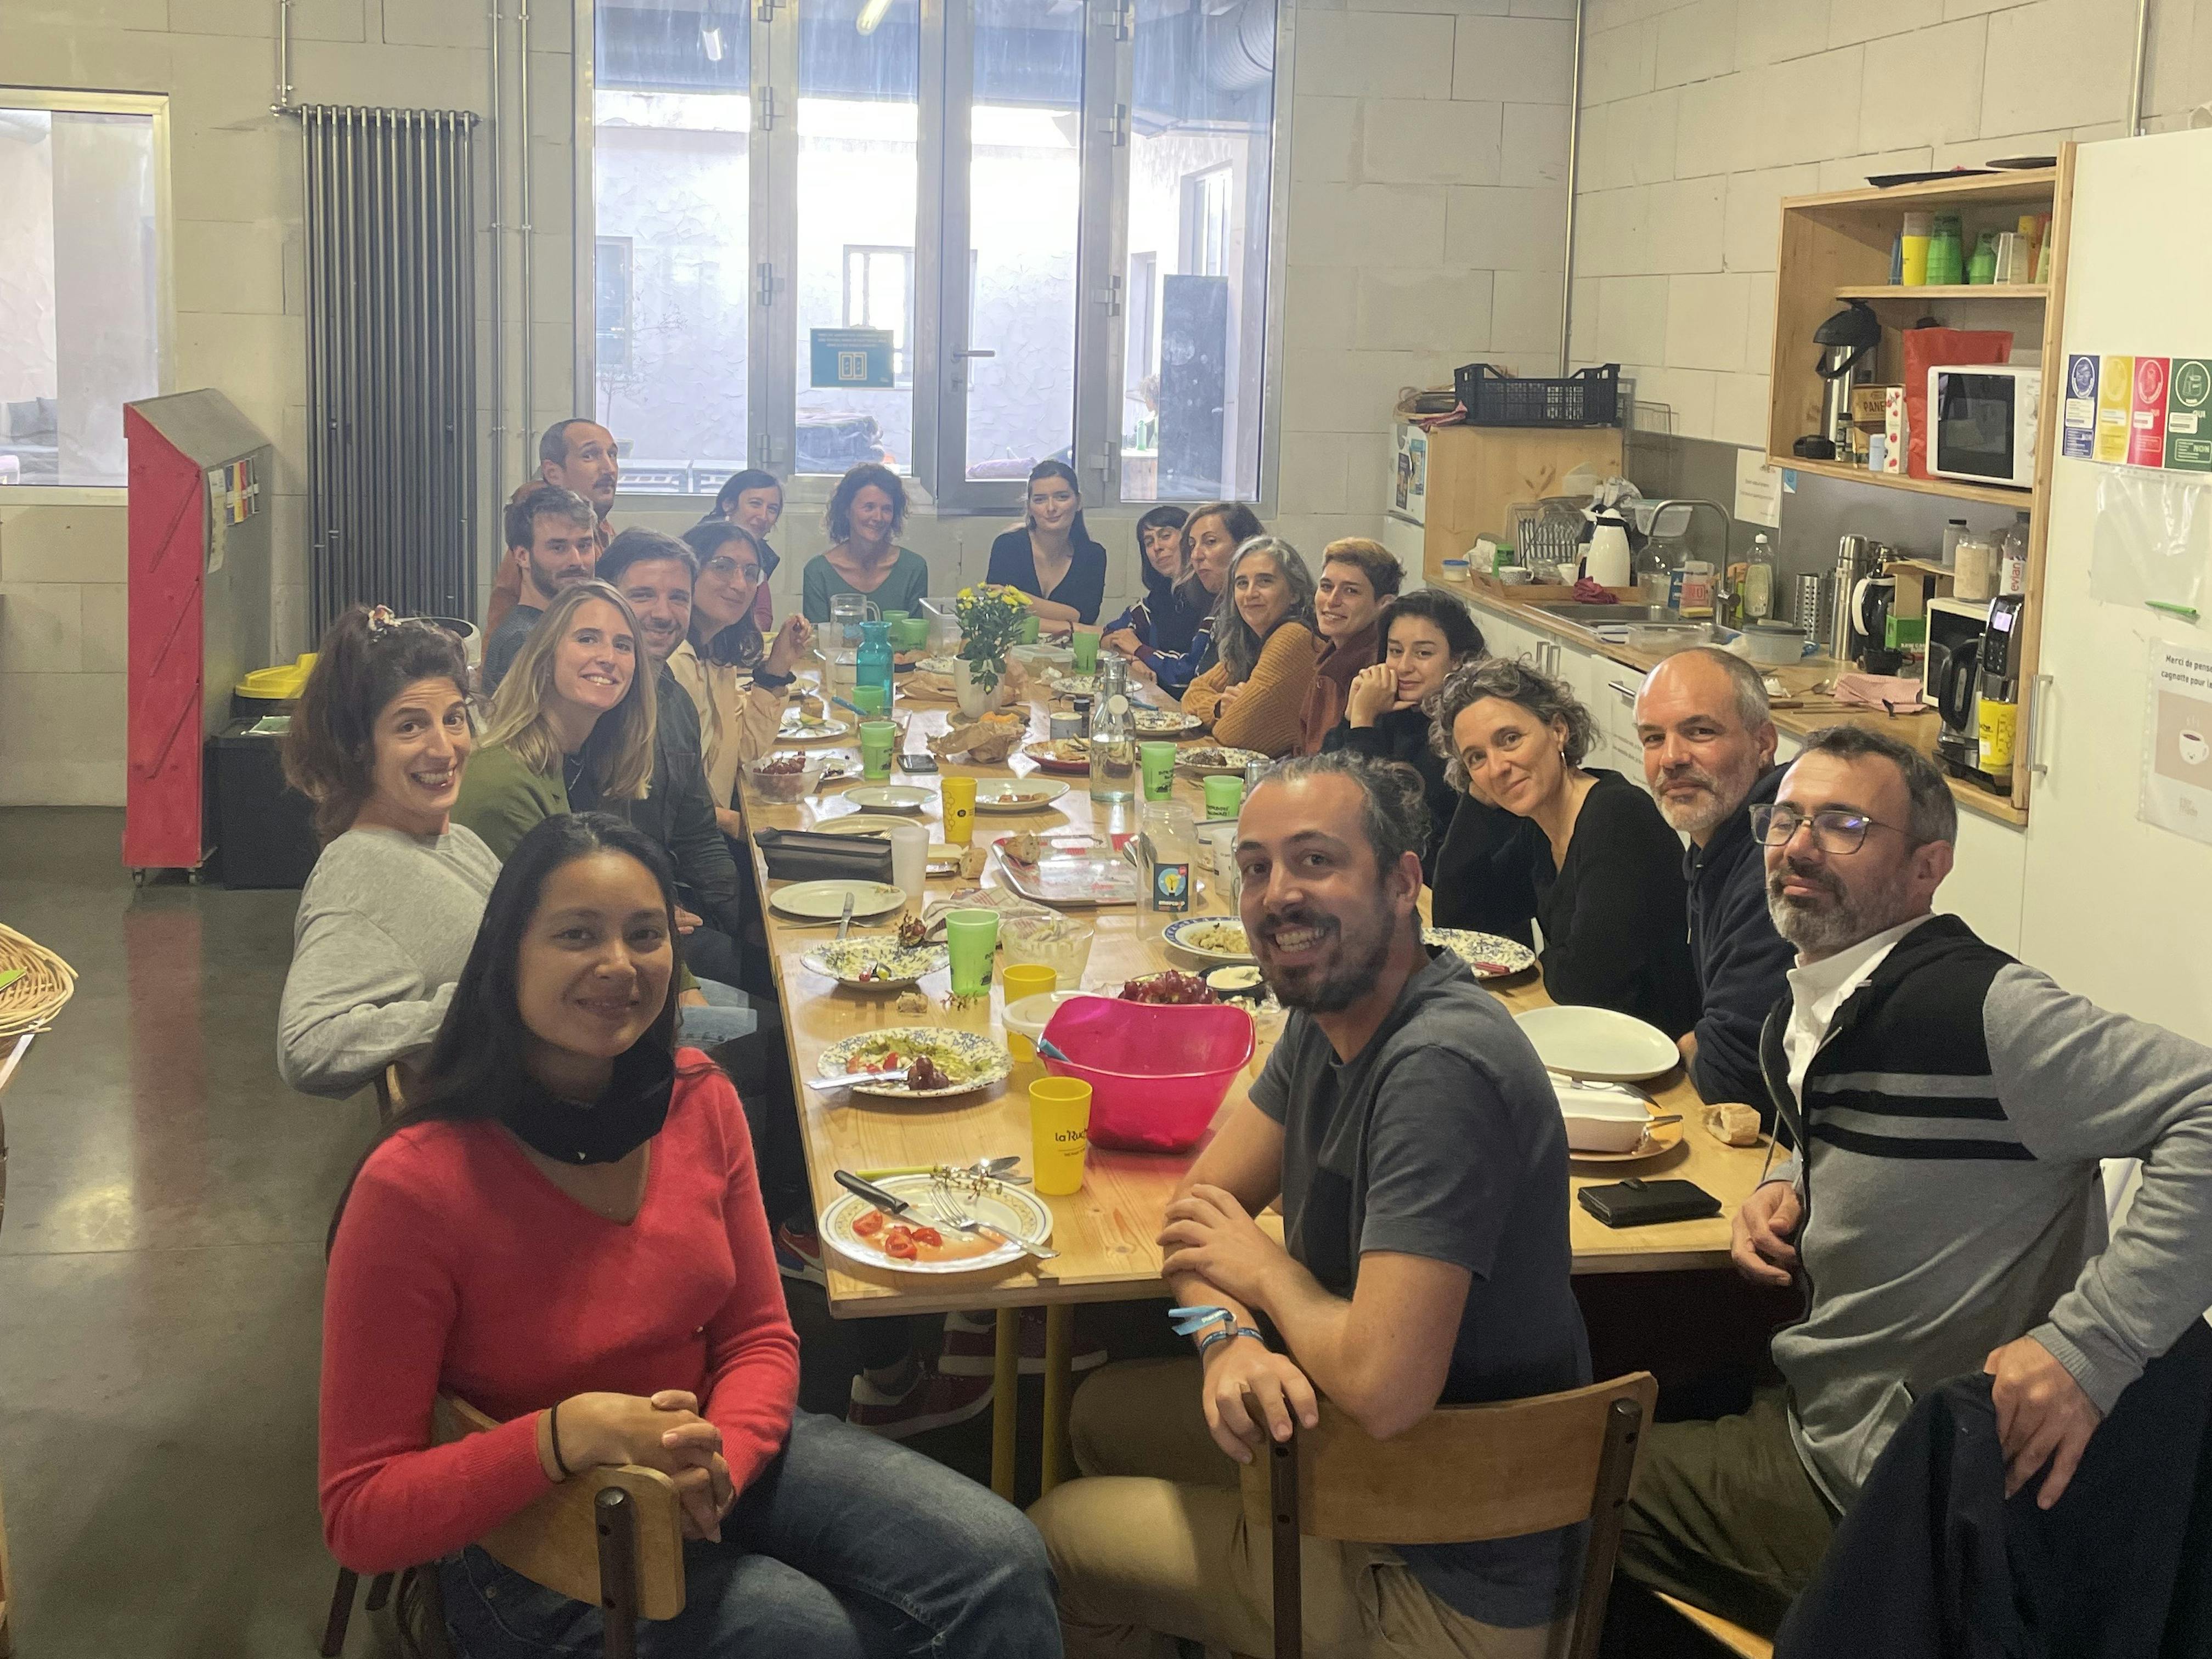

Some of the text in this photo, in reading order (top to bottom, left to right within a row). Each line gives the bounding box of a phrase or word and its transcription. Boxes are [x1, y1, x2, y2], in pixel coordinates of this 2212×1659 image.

[2011, 562, 2021, 591] evian
[2165, 654, 2184, 665] Merci
[2161, 670, 2190, 683] cagnotte
[2190, 678, 2205, 686] pour
[1055, 1132, 1066, 1142] la
